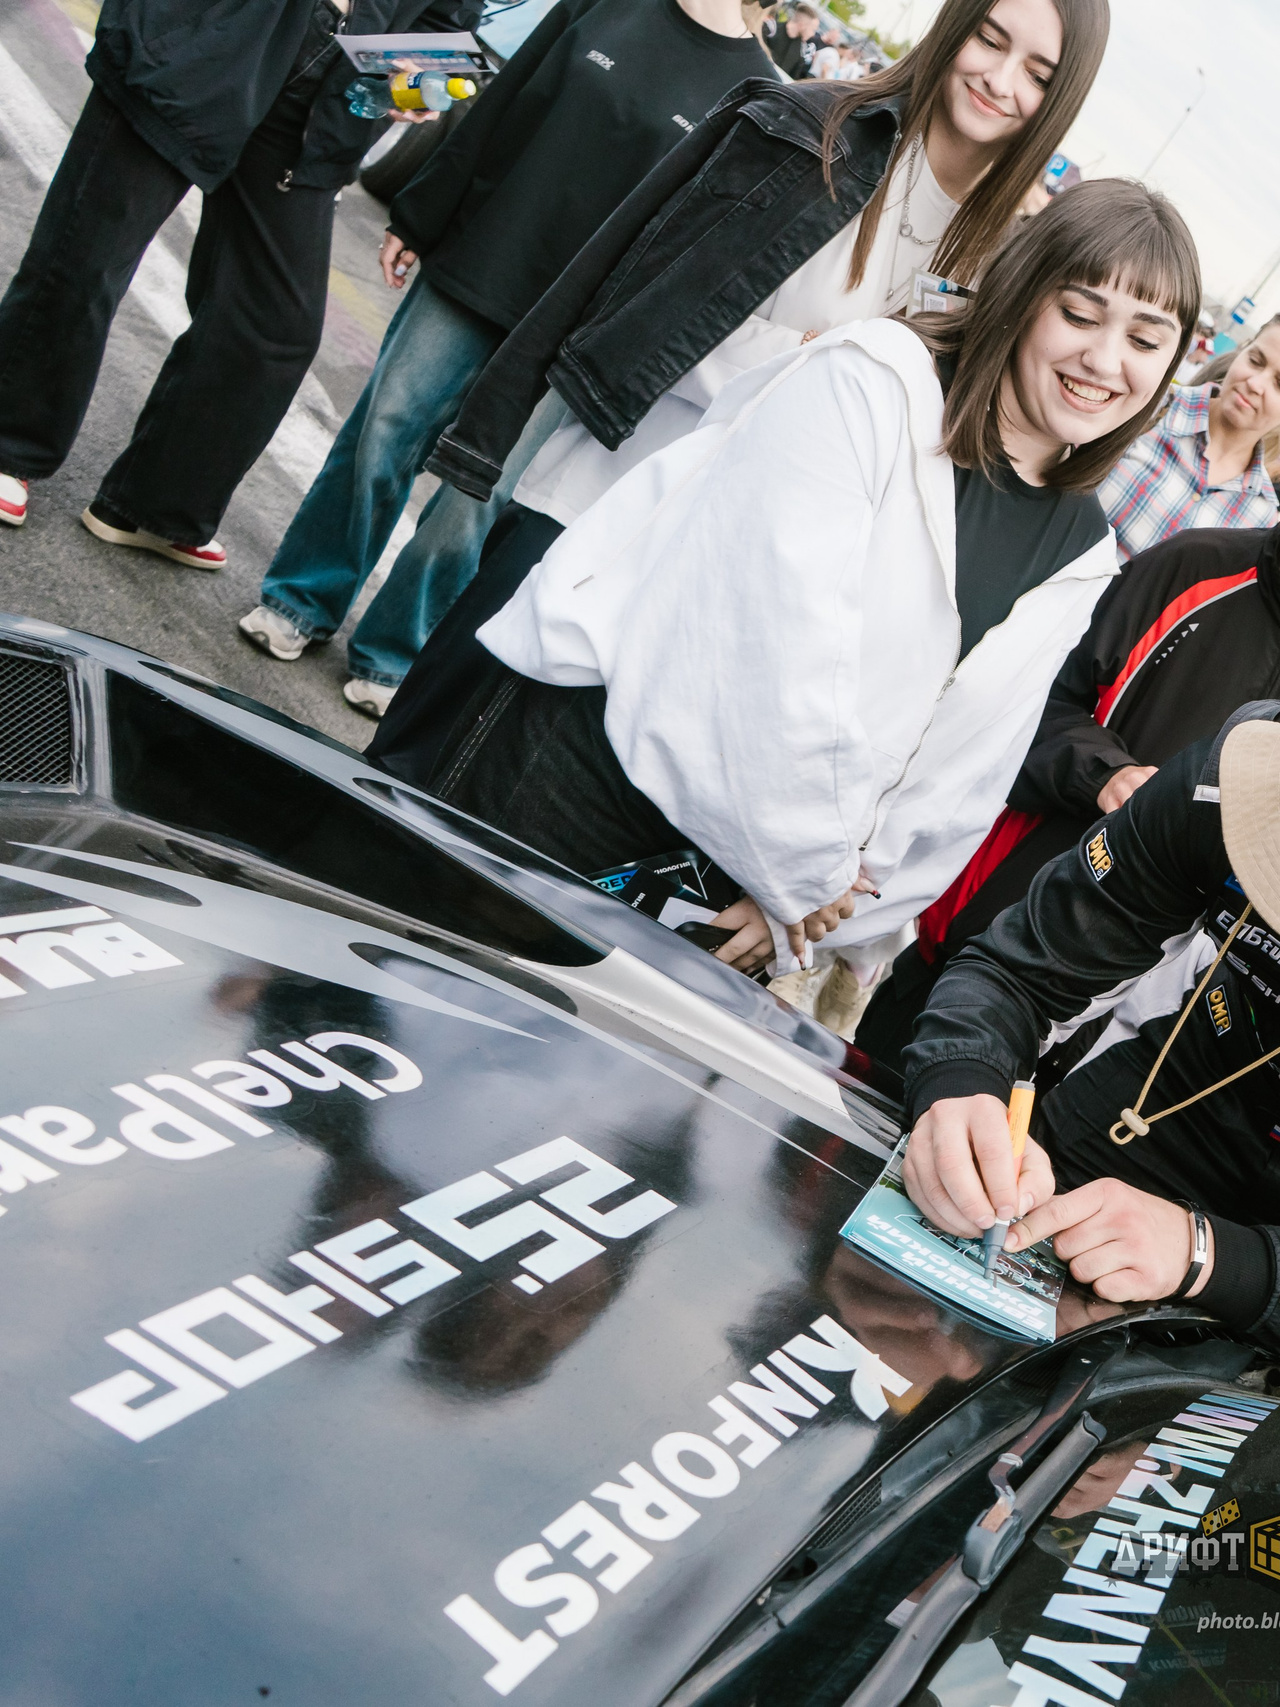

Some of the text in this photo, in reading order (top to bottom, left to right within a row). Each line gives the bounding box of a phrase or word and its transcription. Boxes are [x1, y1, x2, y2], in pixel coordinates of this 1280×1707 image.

[1209, 990, 1230, 1029] OMP
[0, 1031, 424, 1216] ChelPar
[444, 1314, 914, 1695] KINFOREST
